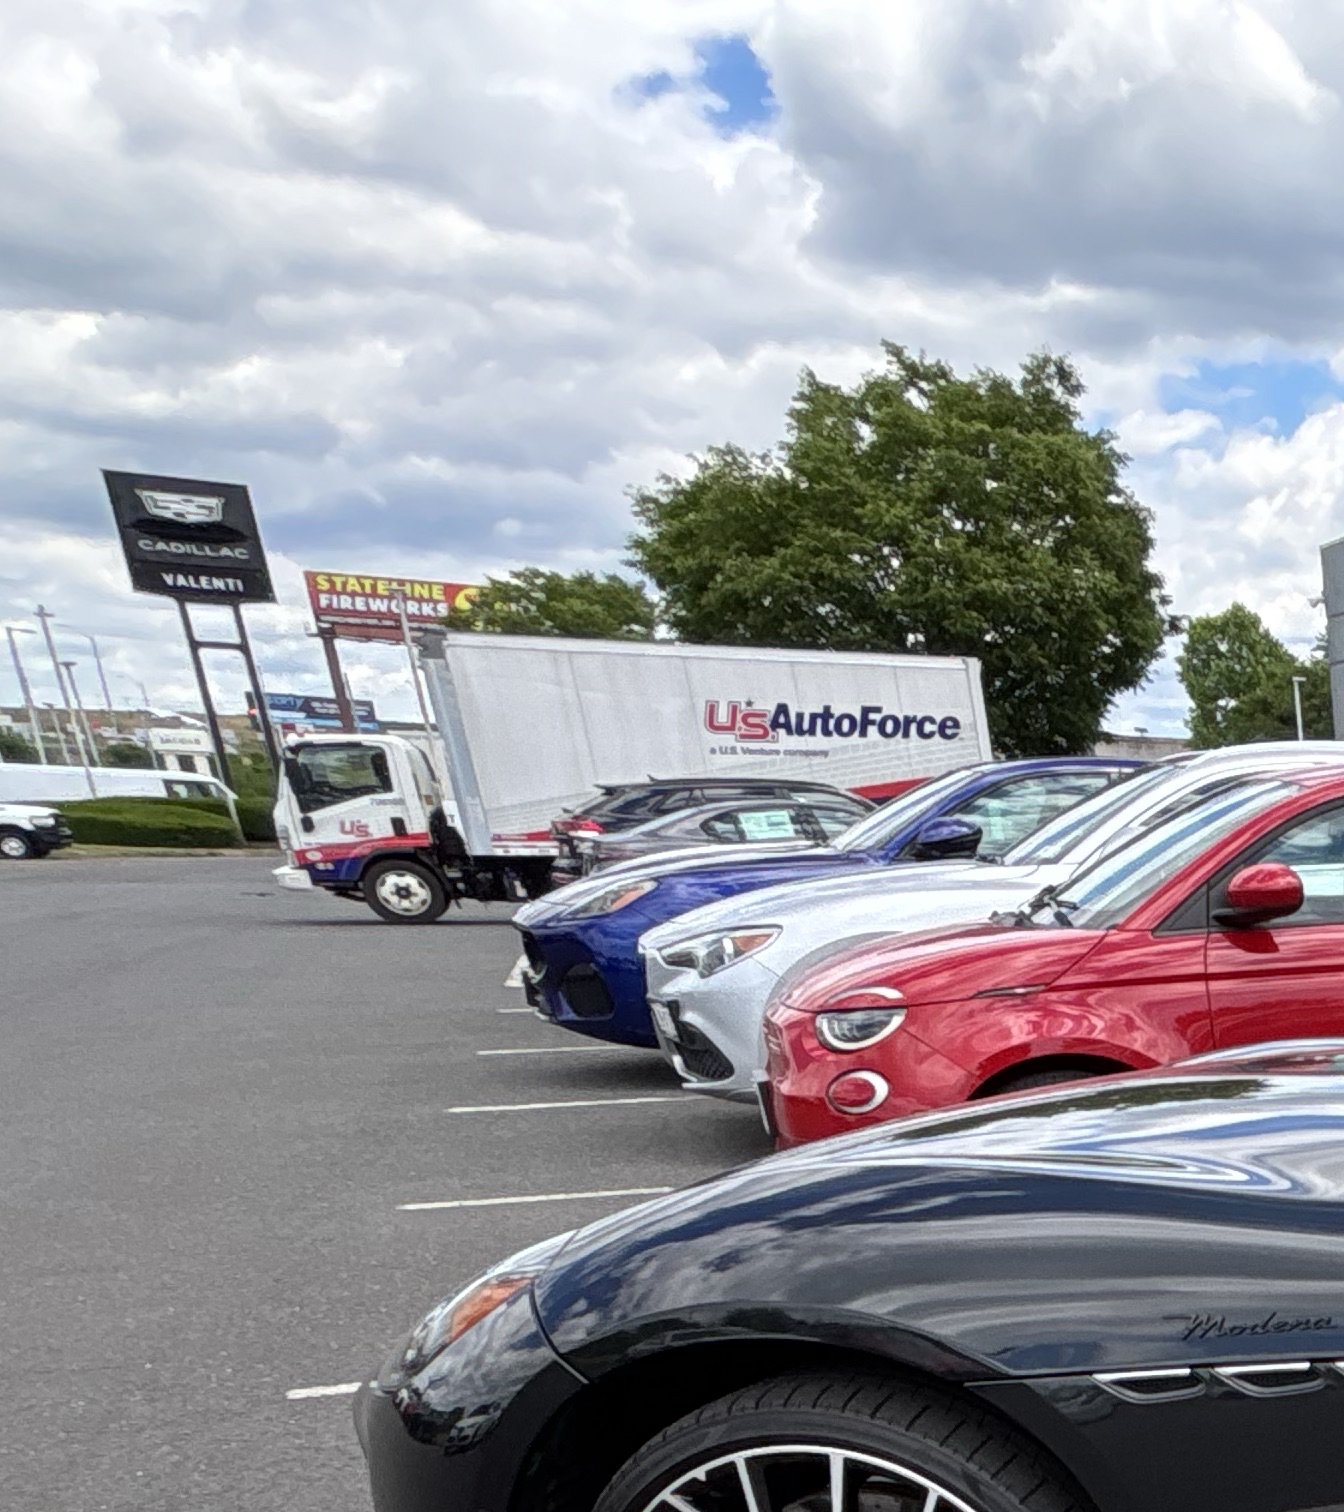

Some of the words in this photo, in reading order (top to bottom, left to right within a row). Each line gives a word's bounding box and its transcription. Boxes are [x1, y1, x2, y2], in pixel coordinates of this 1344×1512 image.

[137, 539, 249, 560] CADILLAC
[160, 572, 244, 592] VALENTI
[1162, 1311, 1338, 1341] Modena
